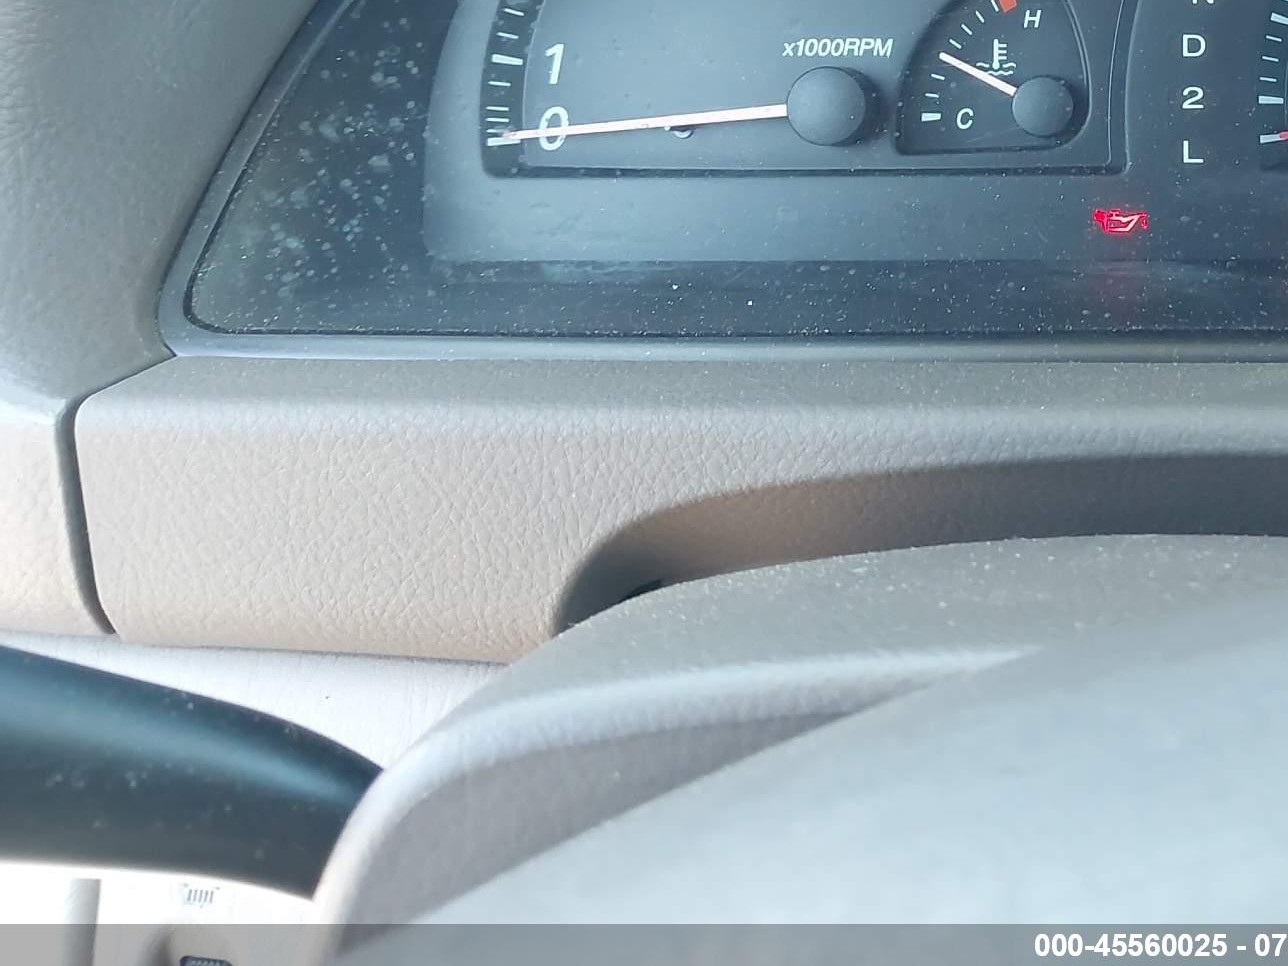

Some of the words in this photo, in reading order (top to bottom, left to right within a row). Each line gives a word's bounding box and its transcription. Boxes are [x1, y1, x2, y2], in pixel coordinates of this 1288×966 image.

[1023, 9, 1042, 28] H
[782, 38, 893, 58] x1000RPM
[1182, 34, 1206, 57] D
[544, 44, 565, 84] 1
[1182, 87, 1204, 109] 2
[538, 106, 569, 151] 0
[956, 108, 974, 130] C
[1182, 140, 1204, 163] L
